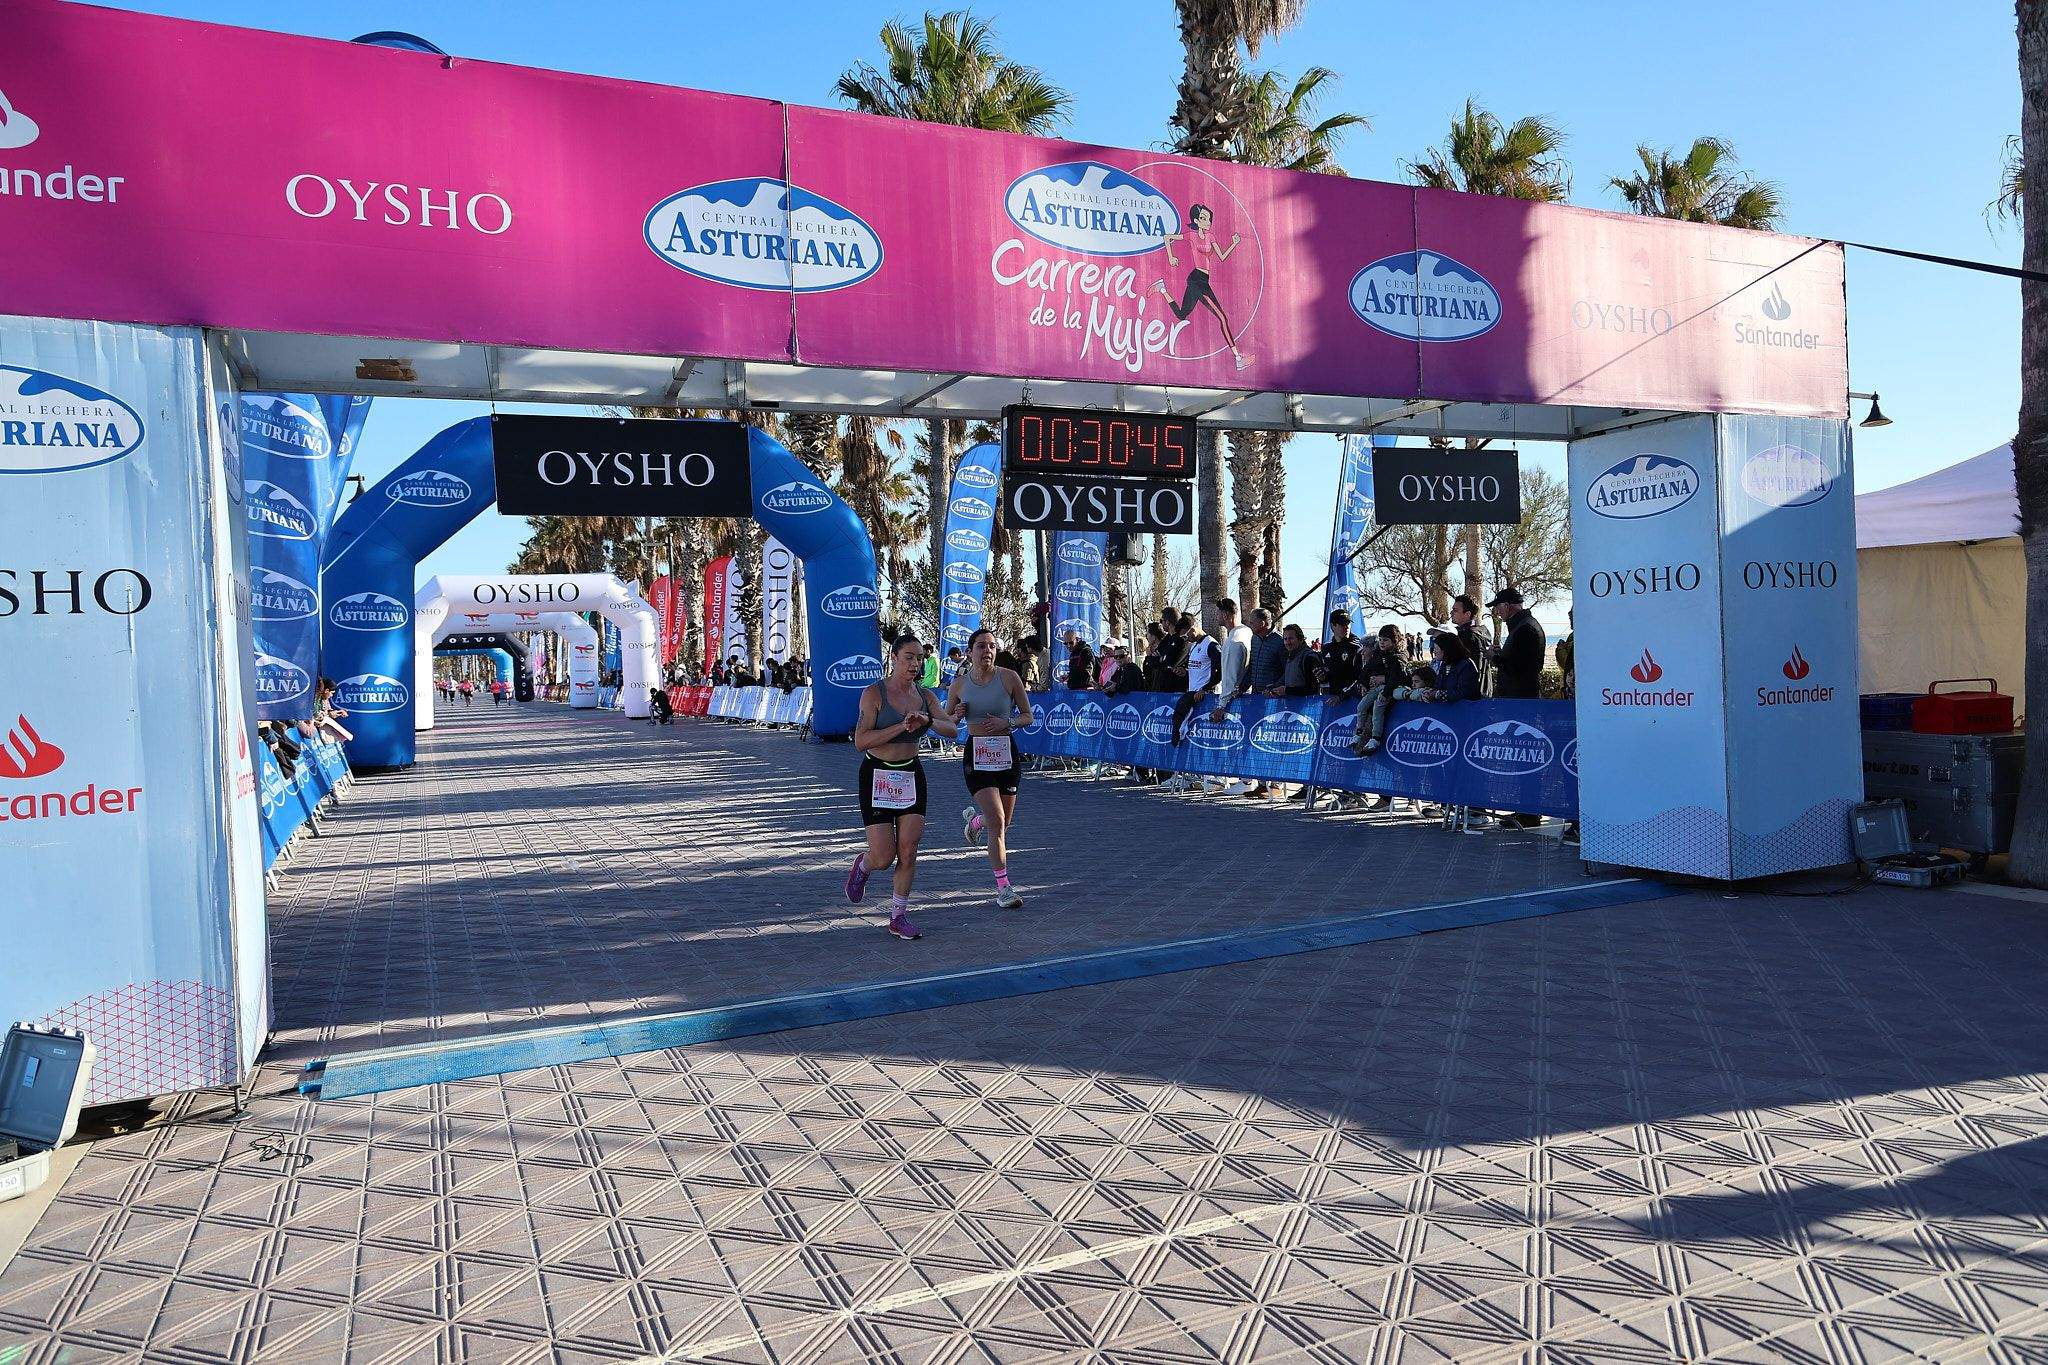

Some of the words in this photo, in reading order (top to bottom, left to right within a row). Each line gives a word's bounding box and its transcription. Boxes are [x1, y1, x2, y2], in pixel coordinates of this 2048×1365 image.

[285, 173, 513, 234] OYSHO
[1019, 187, 1166, 237] ASTURIANA
[1045, 188, 1101, 204] CENTRAL
[1106, 196, 1162, 210] LECHERA
[702, 212, 778, 228] CENTRAL
[785, 220, 858, 237] LECHERA
[664, 211, 867, 270] ASTURIANA
[991, 238, 1137, 299] Carrera
[1361, 278, 1491, 321] ASTURIANA
[1385, 278, 1434, 291] CENTRAL
[1437, 283, 1486, 297] LECHERA
[1571, 300, 1672, 336] OYSHO
[1029, 293, 1057, 327] de
[1063, 295, 1083, 330] la
[1079, 296, 1191, 373] Mujer
[1734, 322, 1819, 350] Santander
[27, 405, 114, 417] LECHERA
[1, 420, 125, 448] RIANA
[1021, 416, 1184, 468] 00:30:45
[537, 450, 716, 488] OYSHO
[1610, 476, 1646, 488] CENTRAL
[391, 484, 465, 498] ASTURIANA
[767, 494, 829, 507] ASTURIANA
[1399, 474, 1500, 502] OYSHO
[1594, 478, 1691, 508] ASTURIANA
[1013, 482, 1185, 527] OYSHO
[1589, 563, 1700, 598] OYSHO
[1743, 560, 1837, 589] OYSHO
[473, 582, 580, 604] OYSHO
[710, 571, 723, 625] Santander
[768, 548, 790, 654] OYSHO
[335, 607, 404, 622] ASTURIANA
[336, 688, 404, 703] ASTURIANA
[1602, 688, 1695, 706] Santander
[1757, 684, 1834, 706] Santander
[1390, 733, 1452, 756] ASTURIANA
[1467, 737, 1546, 764] ASTURIANA
